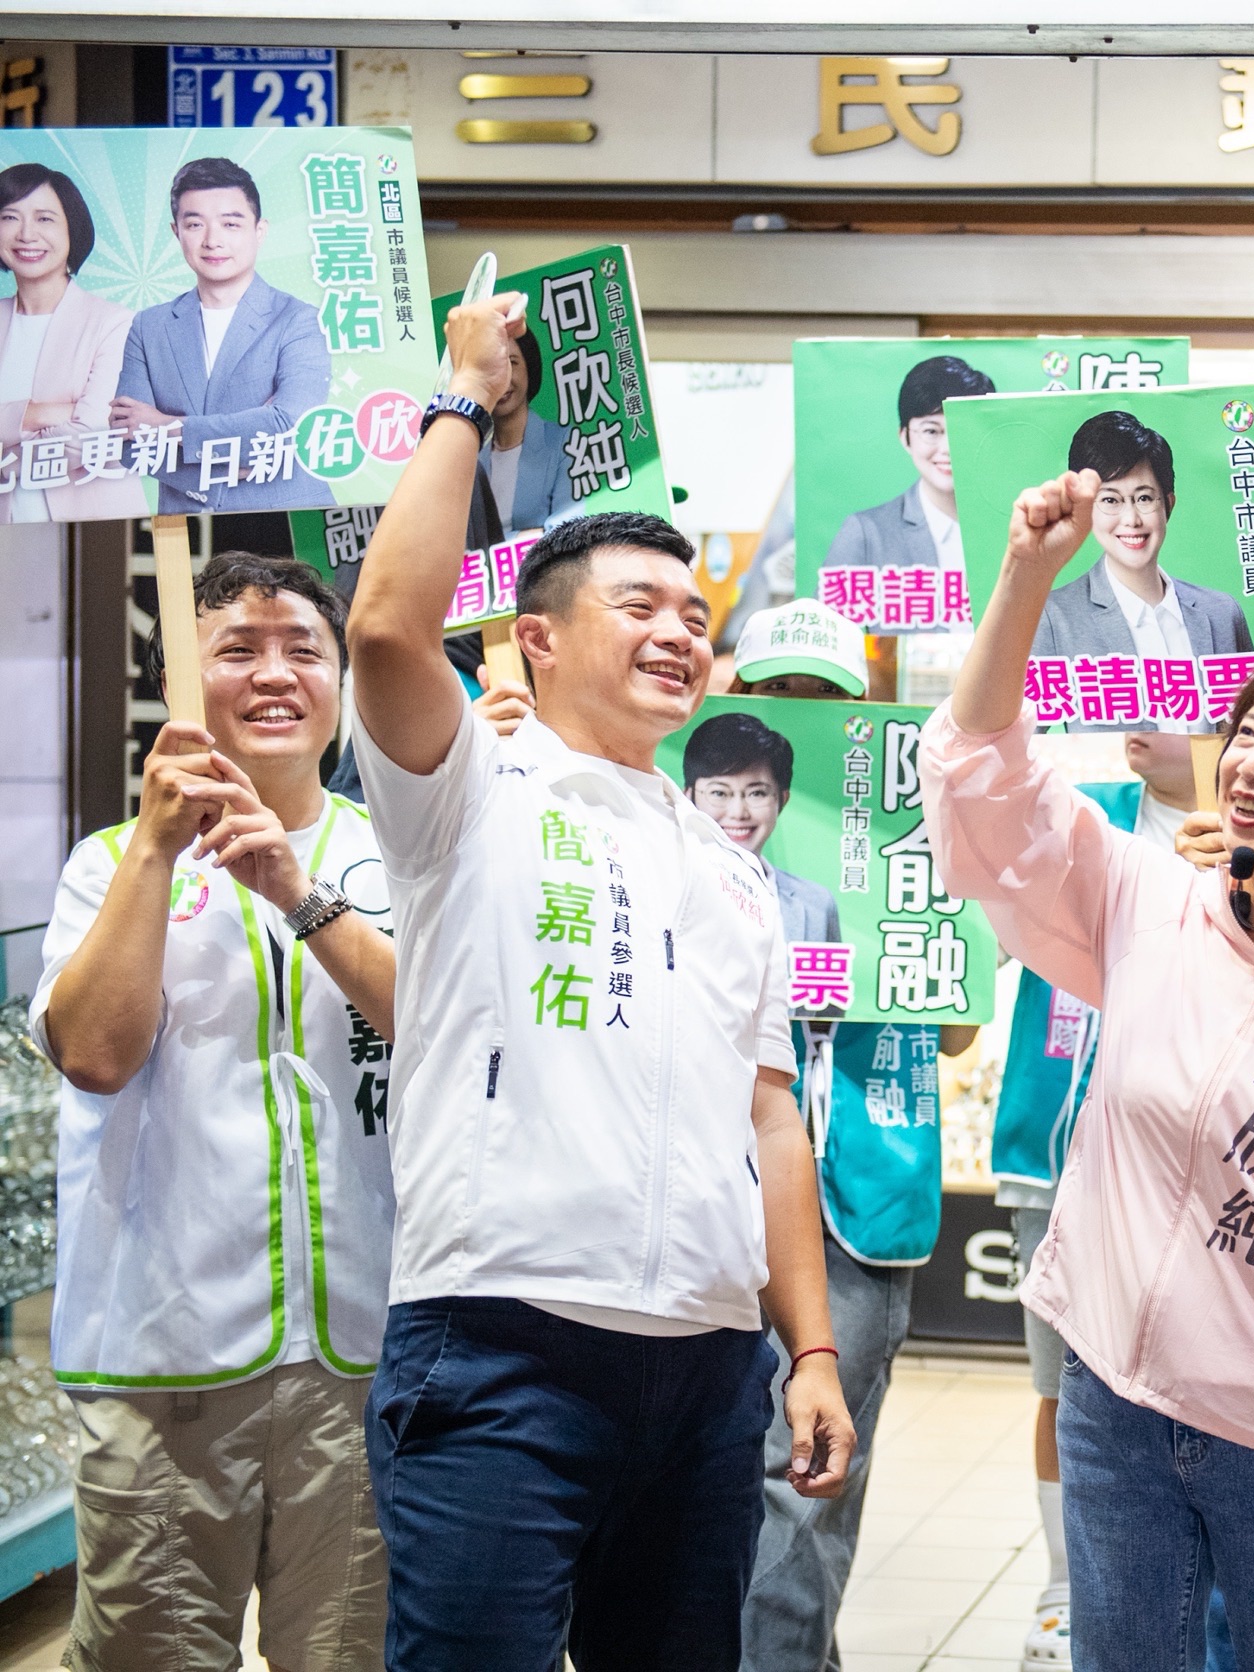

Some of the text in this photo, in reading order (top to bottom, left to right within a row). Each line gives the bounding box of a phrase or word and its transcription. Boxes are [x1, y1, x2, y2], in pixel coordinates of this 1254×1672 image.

[210, 71, 329, 127] 123
[301, 154, 383, 353] 簡嘉佑
[381, 183, 402, 222] 北區
[386, 228, 416, 342] 市議員候選人
[540, 267, 632, 502] 何欣純
[603, 281, 648, 441] 台中市長候選人
[770, 628, 830, 648] 陳俞融
[842, 747, 873, 892] 台中市議員
[530, 809, 597, 1032] 簡嘉佑
[606, 857, 633, 1029] 市議員參選人
[908, 1028, 939, 1128] 市議員
